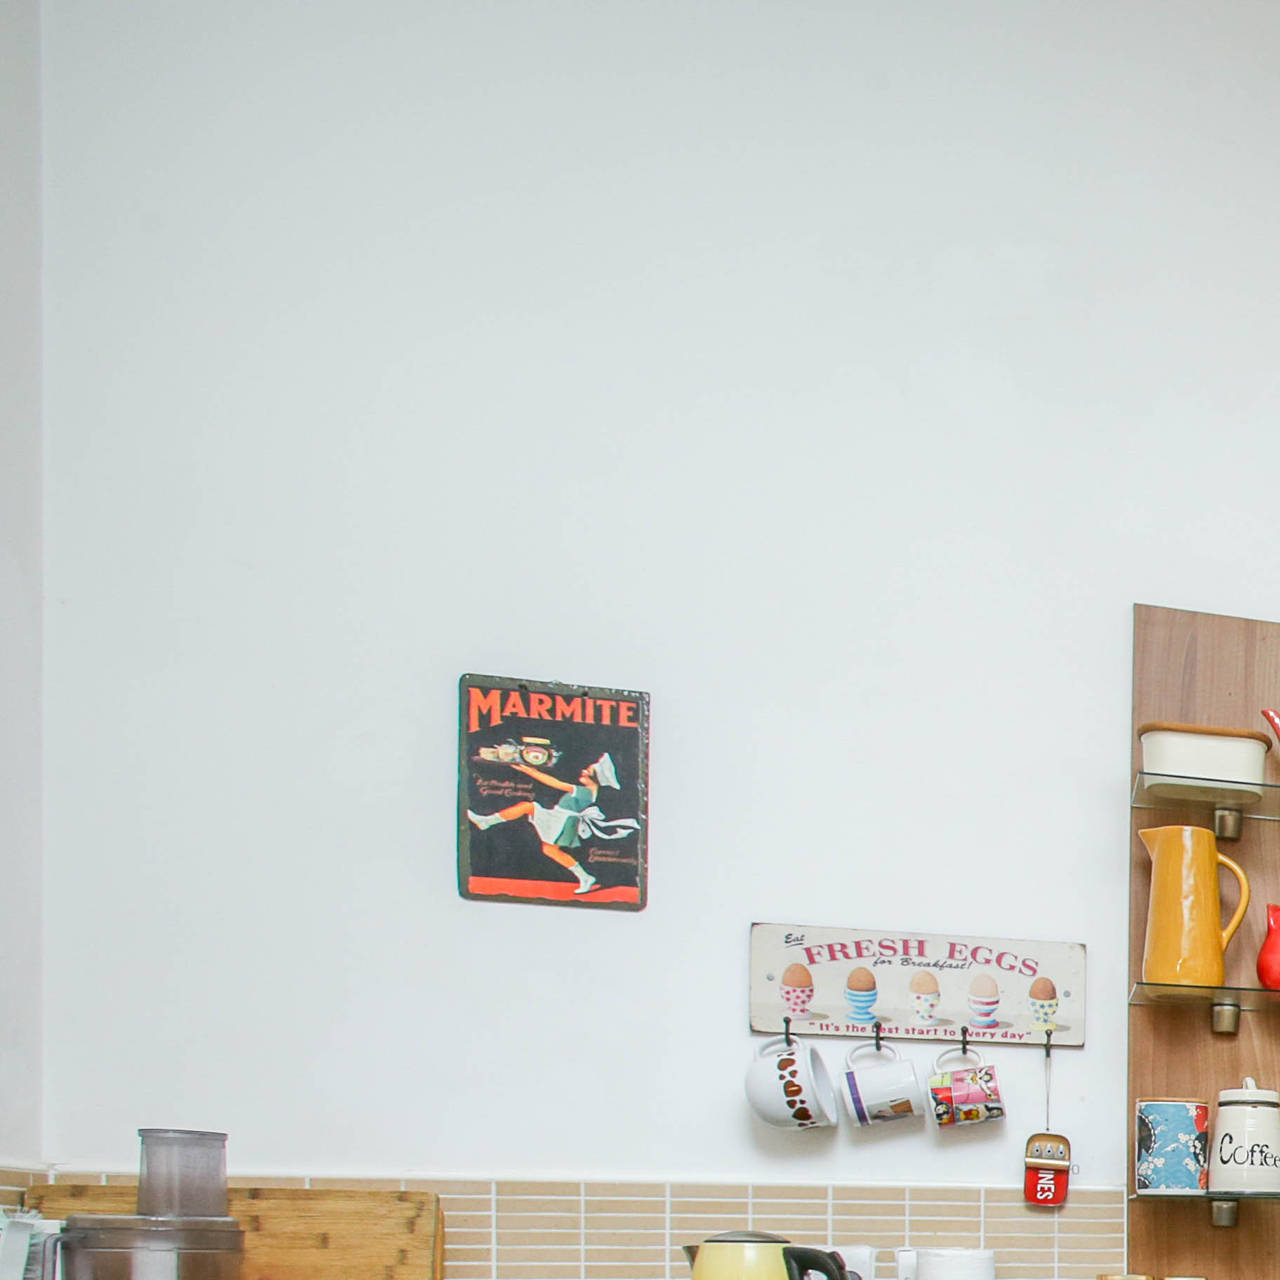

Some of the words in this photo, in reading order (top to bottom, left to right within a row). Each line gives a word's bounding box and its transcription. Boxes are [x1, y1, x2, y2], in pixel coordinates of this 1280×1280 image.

[468, 686, 640, 733] MARMITE
[784, 933, 805, 945] Eat
[803, 937, 928, 966] FRESH
[946, 941, 1040, 978] EGGS
[872, 957, 892, 968] for
[900, 957, 973, 971] Breakfast!
[845, 1024, 867, 1033] the
[904, 1027, 938, 1036] start
[943, 1028, 956, 1037] to
[962, 1029, 996, 1039] very
[1219, 1132, 1280, 1168] Coffee
